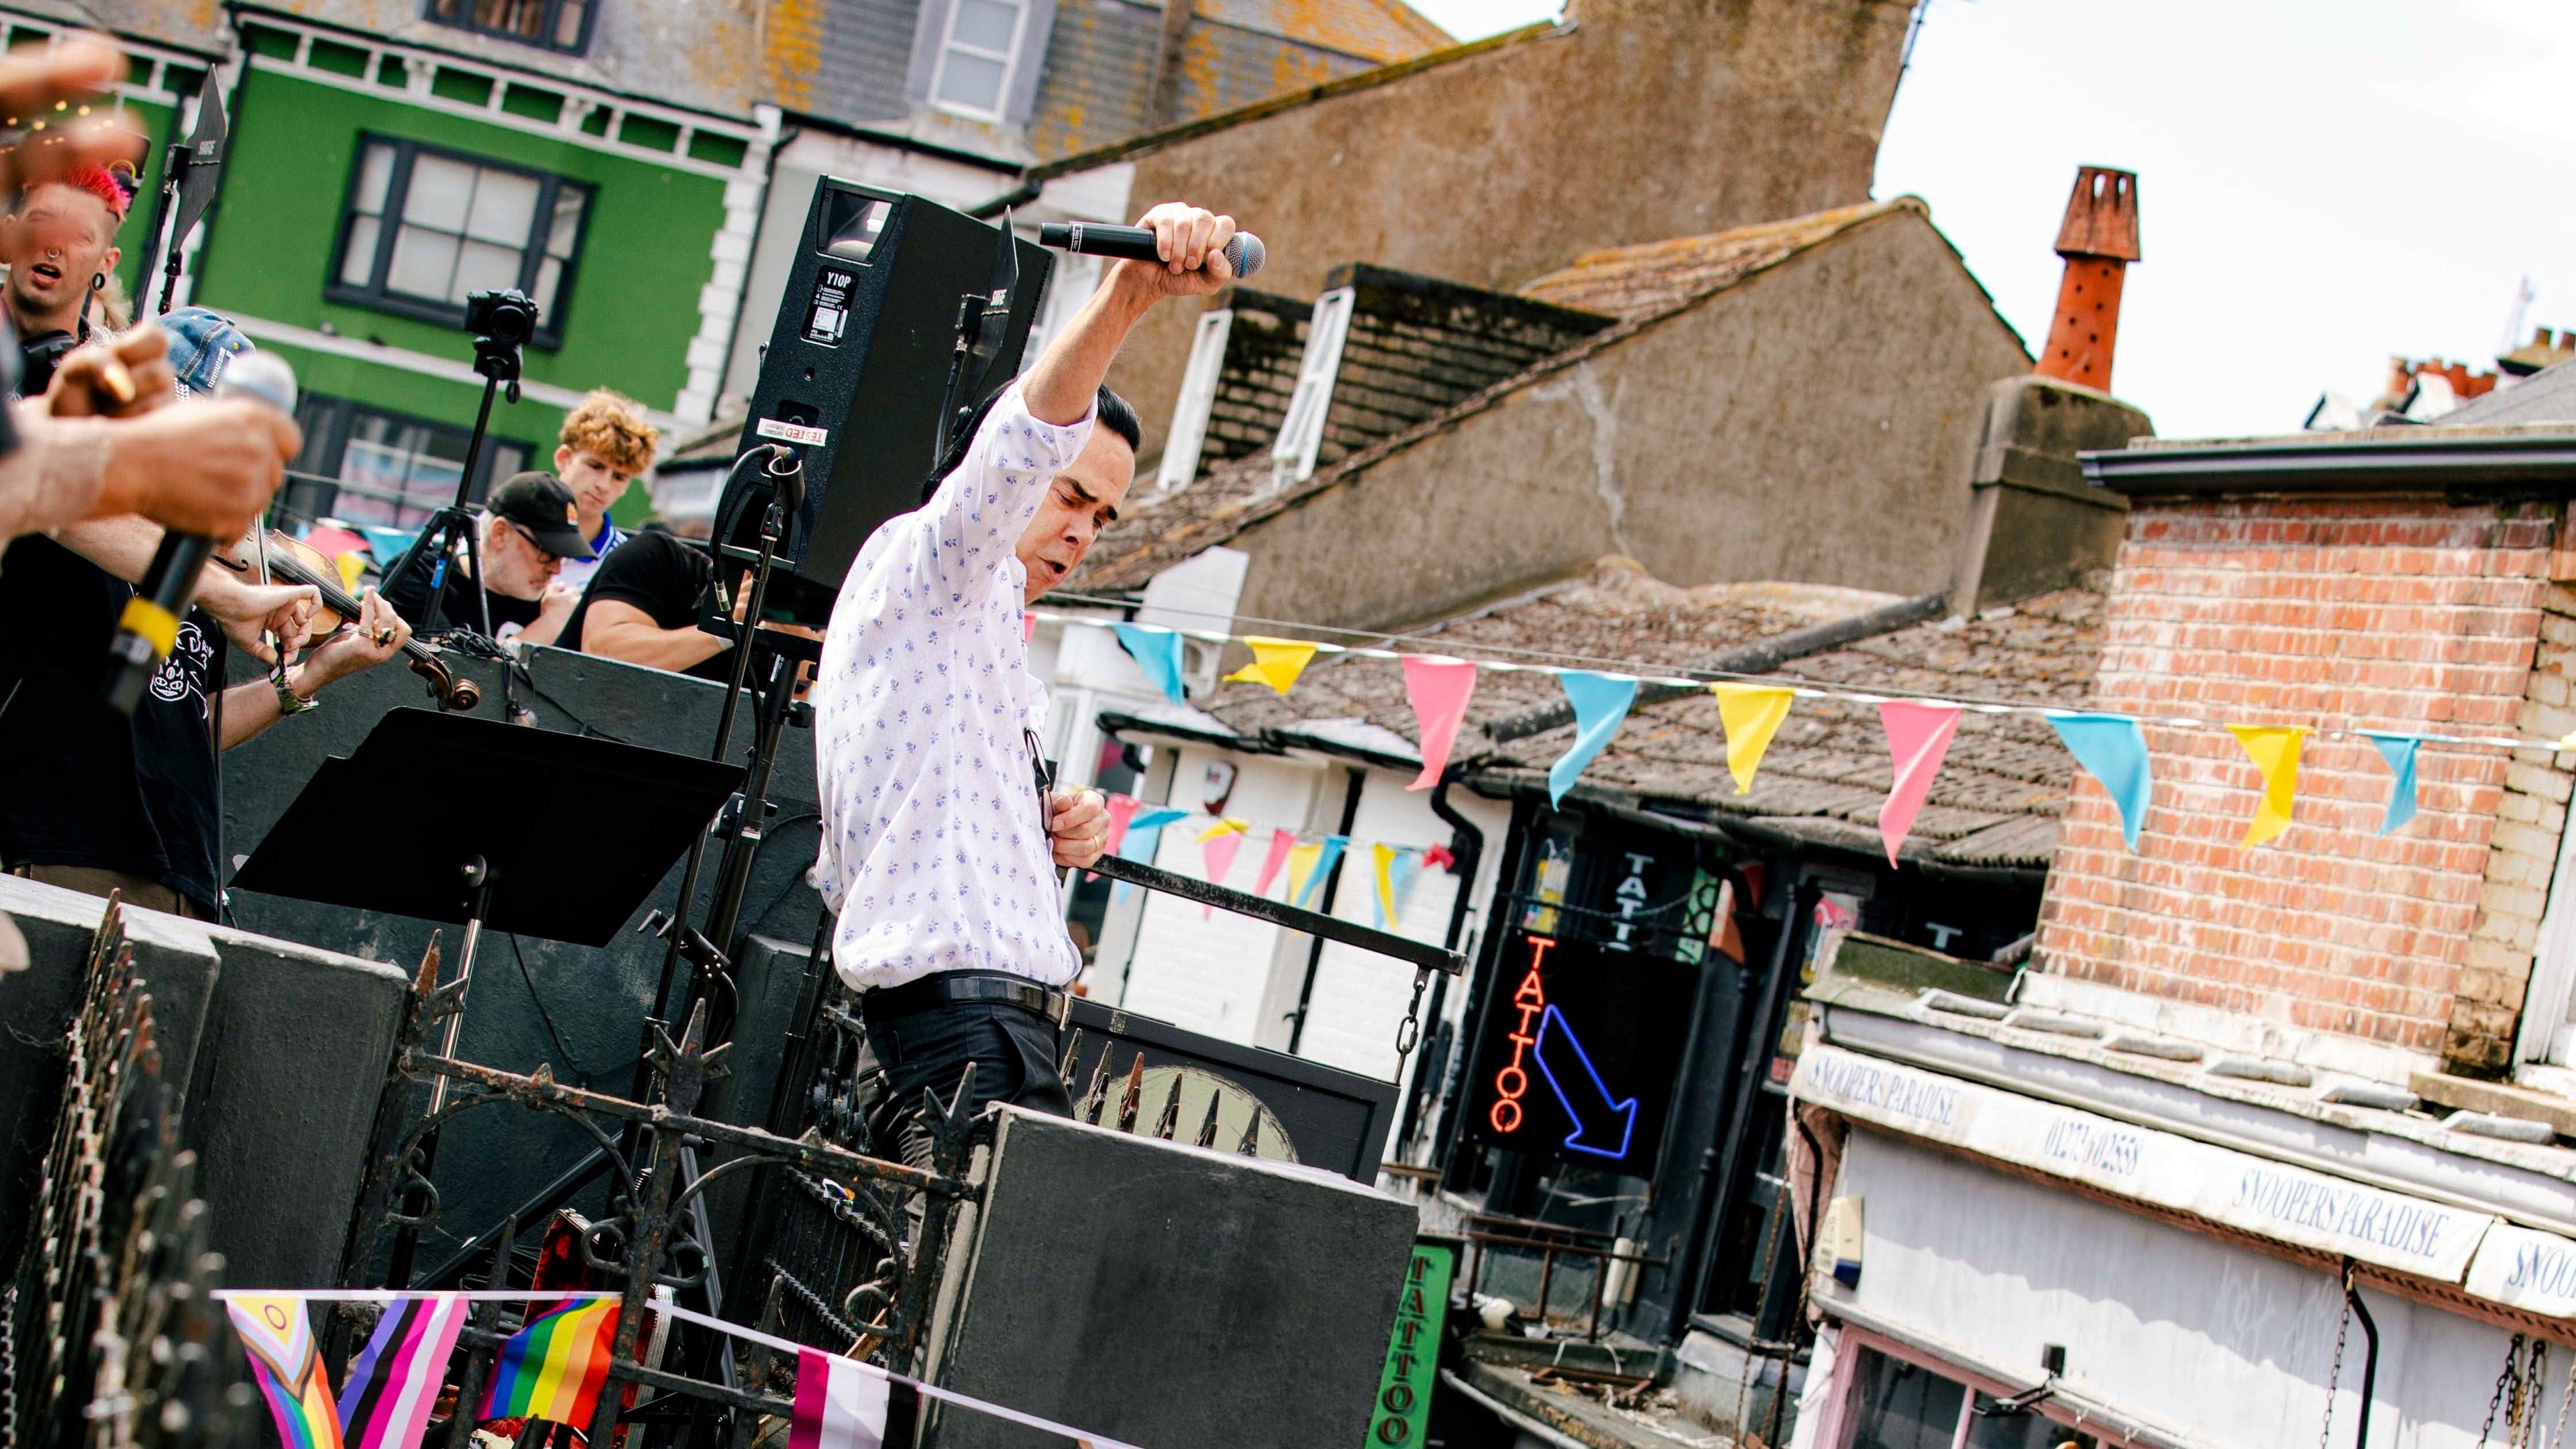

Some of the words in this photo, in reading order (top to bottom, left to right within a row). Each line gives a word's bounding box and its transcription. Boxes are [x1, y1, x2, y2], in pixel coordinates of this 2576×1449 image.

[826, 271, 851, 288] Y10P
[785, 427, 822, 443] TESTED
[1607, 852, 1655, 951] TATT
[1490, 935, 1556, 1133] TATTOO
[1882, 1075, 1961, 1126] PARADISE
[2232, 1167, 2343, 1228] SNOOPERS
[2335, 1192, 2451, 1258] PARADISE
[2508, 1239, 2576, 1300] SNOO
[1377, 1255, 1434, 1445] TATTOO
